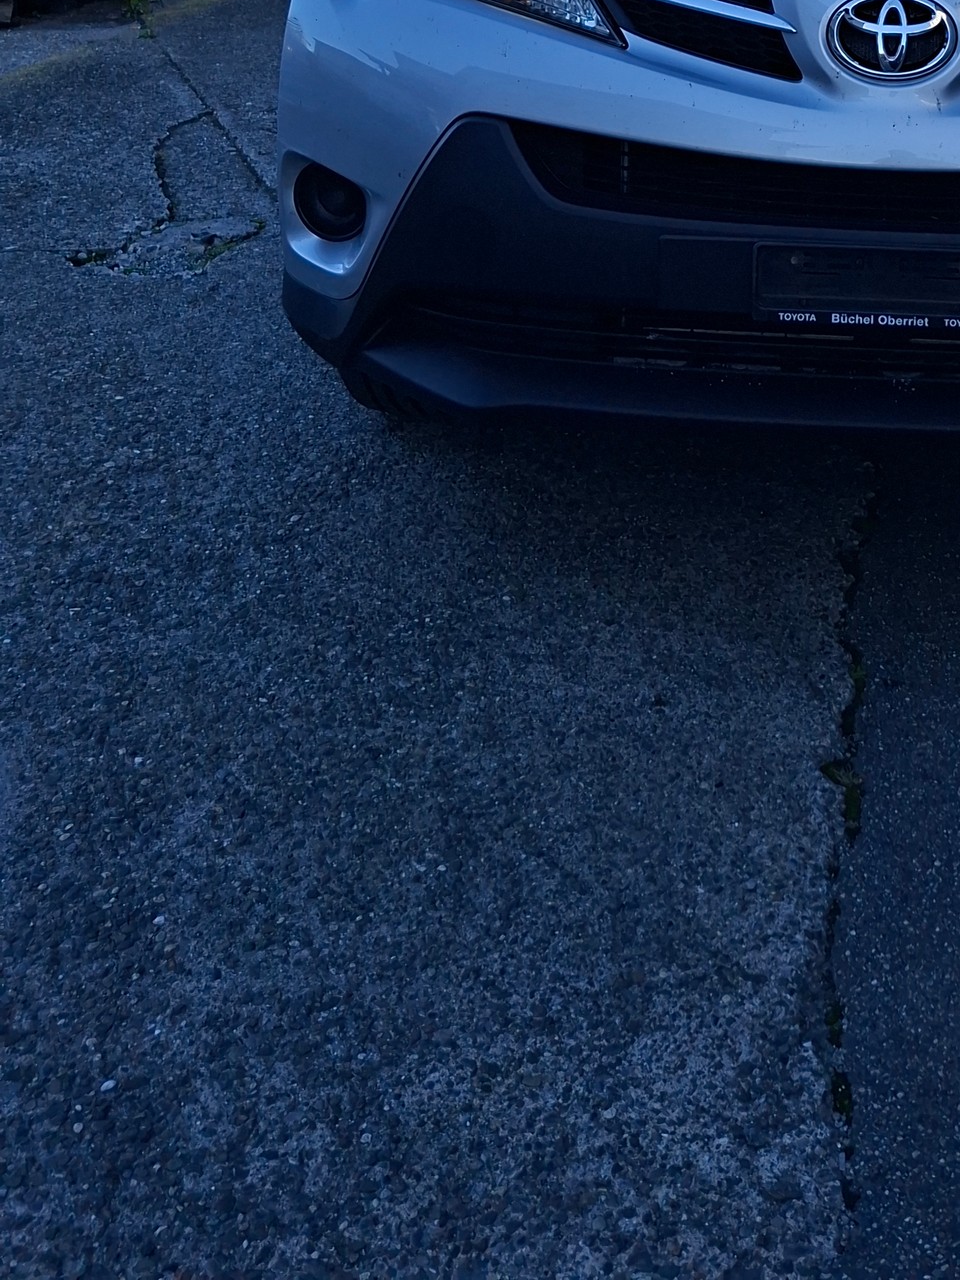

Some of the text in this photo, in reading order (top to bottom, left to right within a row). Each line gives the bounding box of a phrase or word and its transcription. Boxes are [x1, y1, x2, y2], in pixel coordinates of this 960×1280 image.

[777, 312, 817, 322] TOYOTA
[831, 312, 874, 324] Büchel
[877, 314, 929, 327] Oberriet
